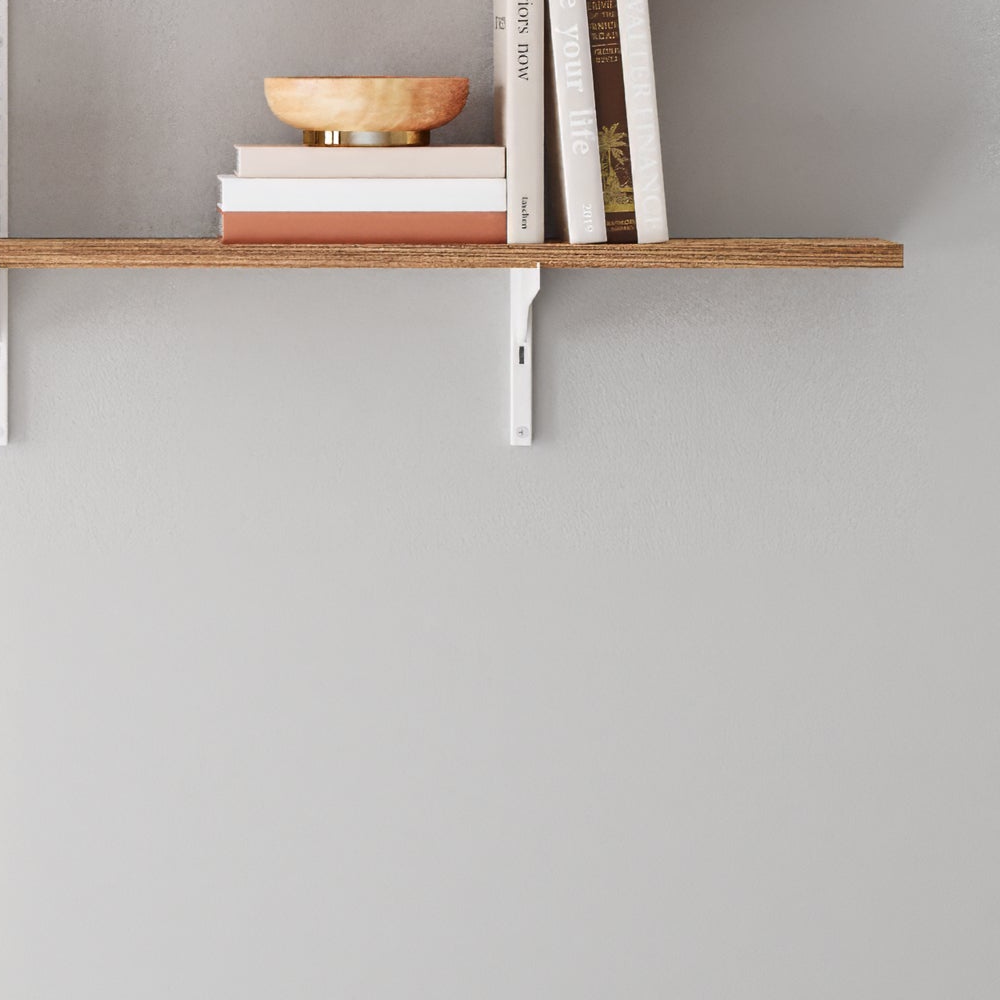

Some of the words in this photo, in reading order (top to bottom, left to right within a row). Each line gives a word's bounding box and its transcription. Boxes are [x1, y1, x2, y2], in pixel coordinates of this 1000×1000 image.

[516, 43, 530, 81] now
[556, 25, 585, 91] your
[569, 109, 595, 155] life
[521, 196, 529, 230] taschen
